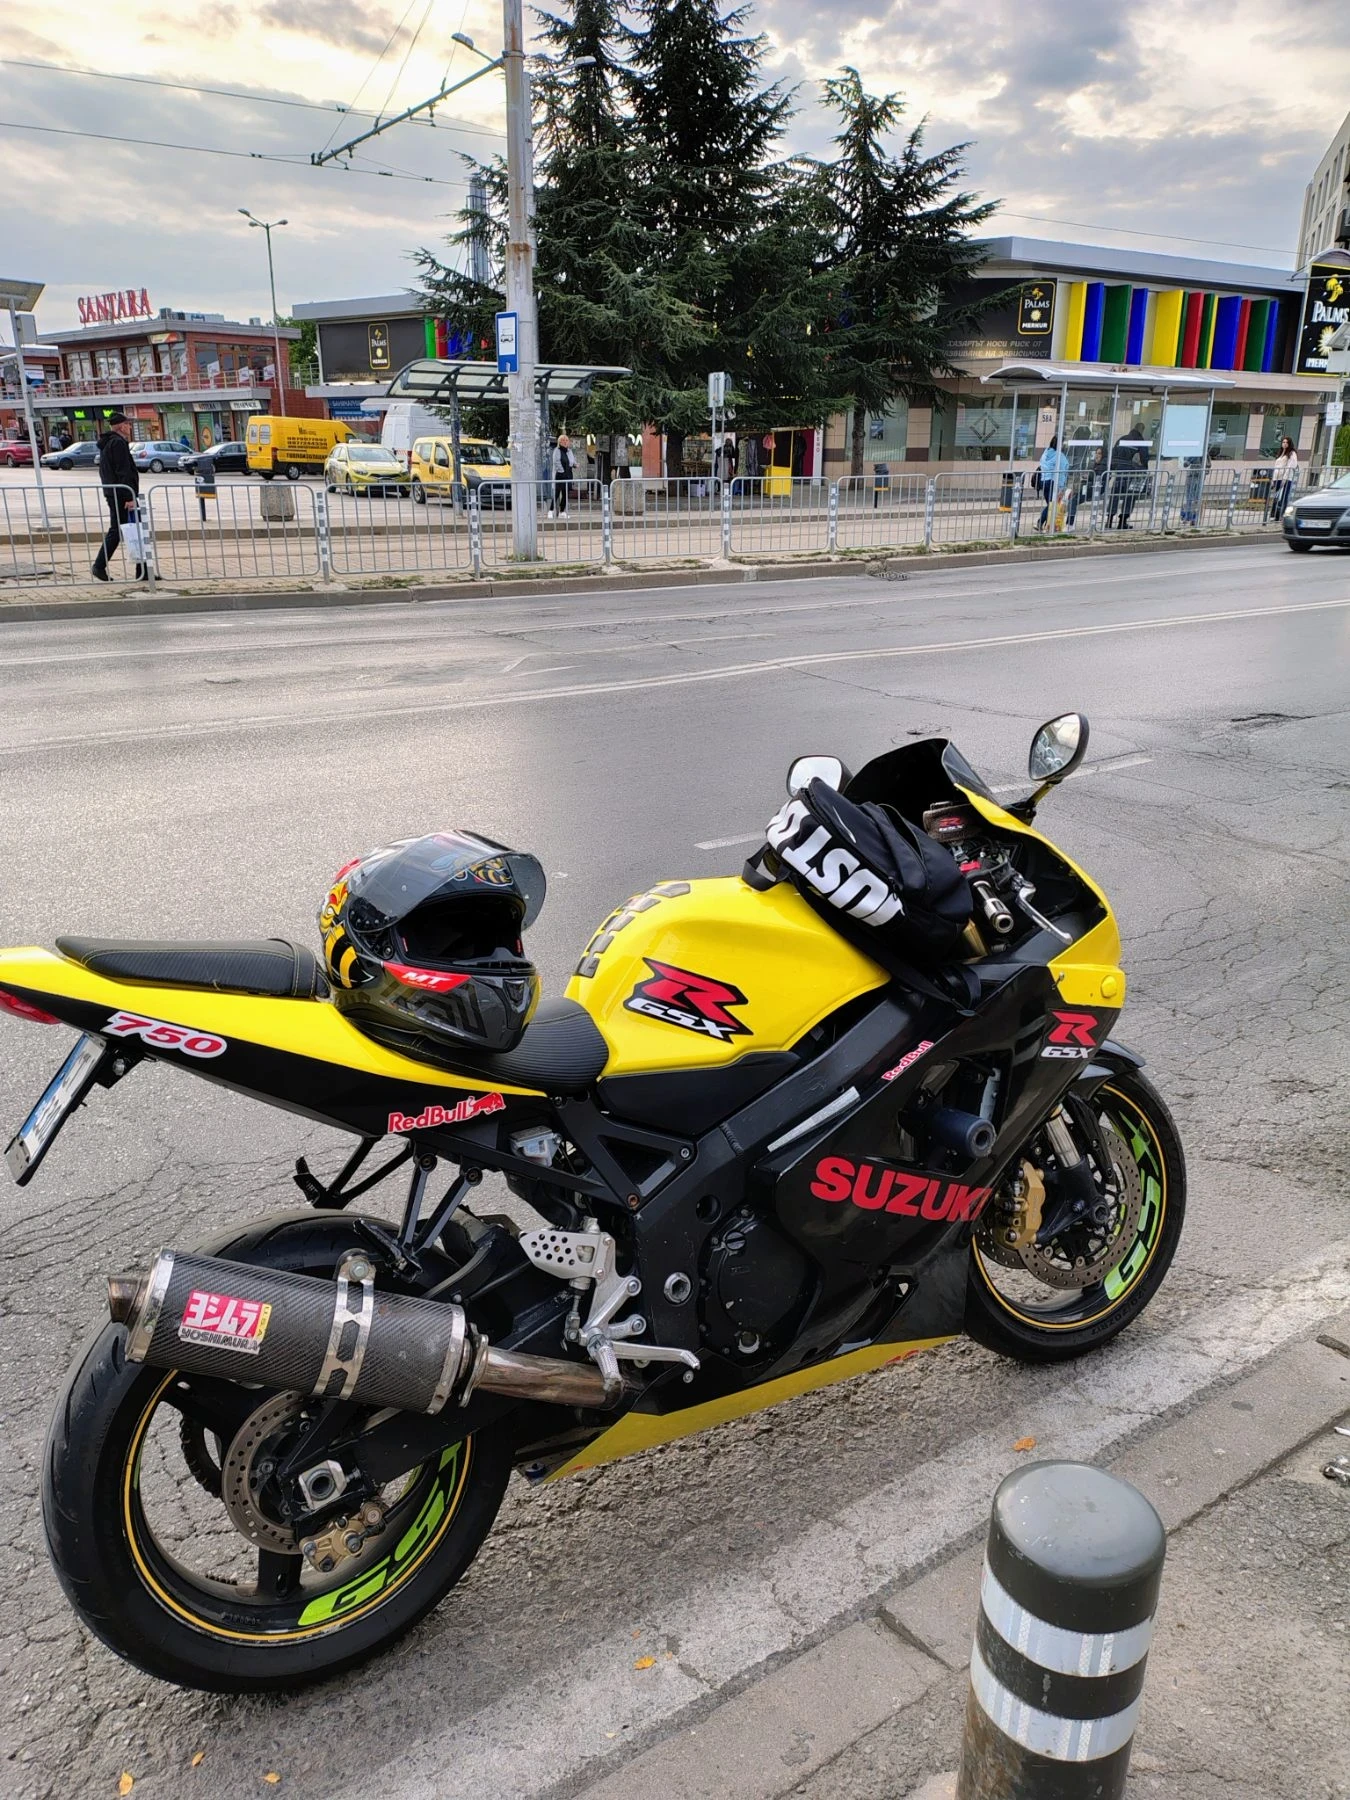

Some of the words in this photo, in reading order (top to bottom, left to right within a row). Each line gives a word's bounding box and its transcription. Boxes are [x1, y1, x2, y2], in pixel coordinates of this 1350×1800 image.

[78, 288, 152, 323] SANTARA
[1024, 299, 1050, 309] PALMS
[1311, 300, 1350, 323] PALMS
[371, 339, 387, 347] PALMS
[401, 971, 453, 985] MT
[641, 959, 740, 1029] R
[627, 996, 738, 1040] GSX
[1048, 1011, 1098, 1046] R
[109, 1013, 223, 1055] 750
[1041, 1046, 1095, 1059] GSX
[184, 1292, 260, 1336] ヨシムラ
[180, 1327, 259, 1351] YOSHIMURA
